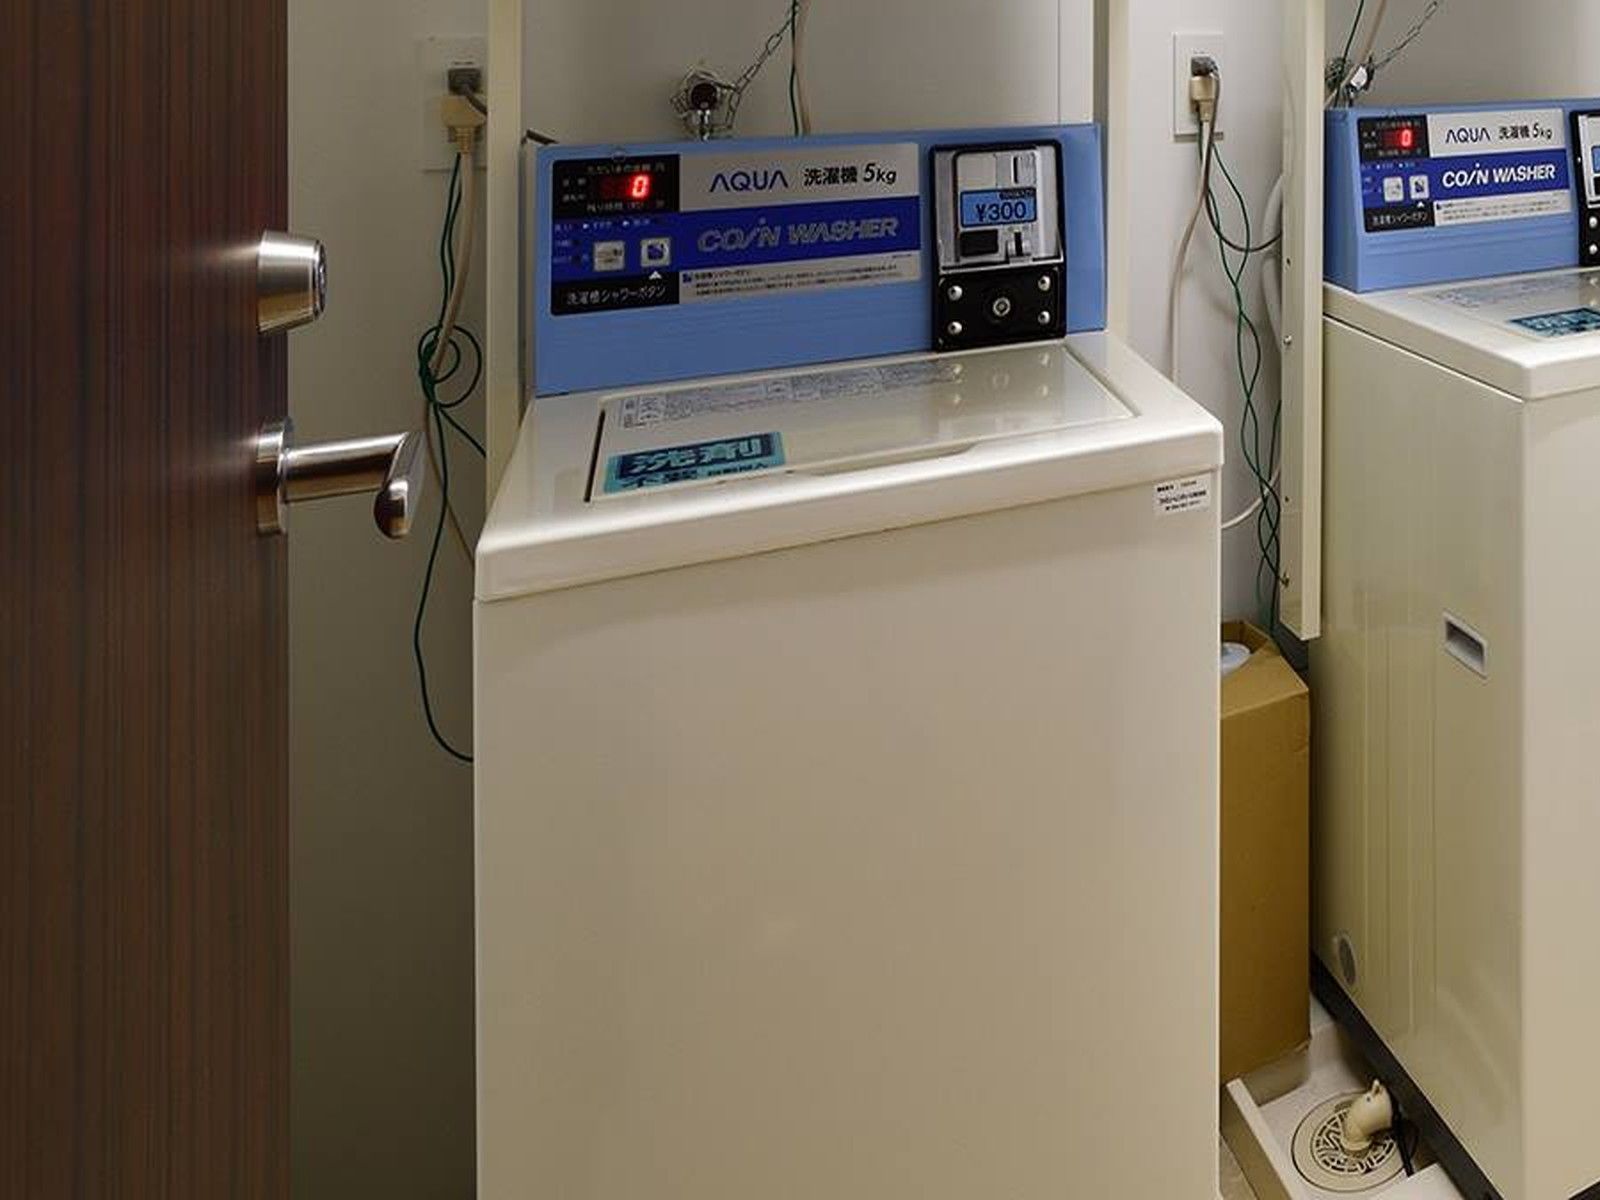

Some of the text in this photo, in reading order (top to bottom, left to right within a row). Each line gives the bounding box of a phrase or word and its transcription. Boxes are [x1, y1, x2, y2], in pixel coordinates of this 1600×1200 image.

[1400, 128, 1413, 148] 0
[1445, 121, 1554, 144] AQUA 洗濯機 5kg
[709, 159, 897, 194] AQUA 洗濯機 5kg
[1493, 163, 1556, 184] WASHER
[631, 173, 652, 199] 0
[975, 201, 1028, 222] ¥300
[789, 217, 898, 248] WASHER
